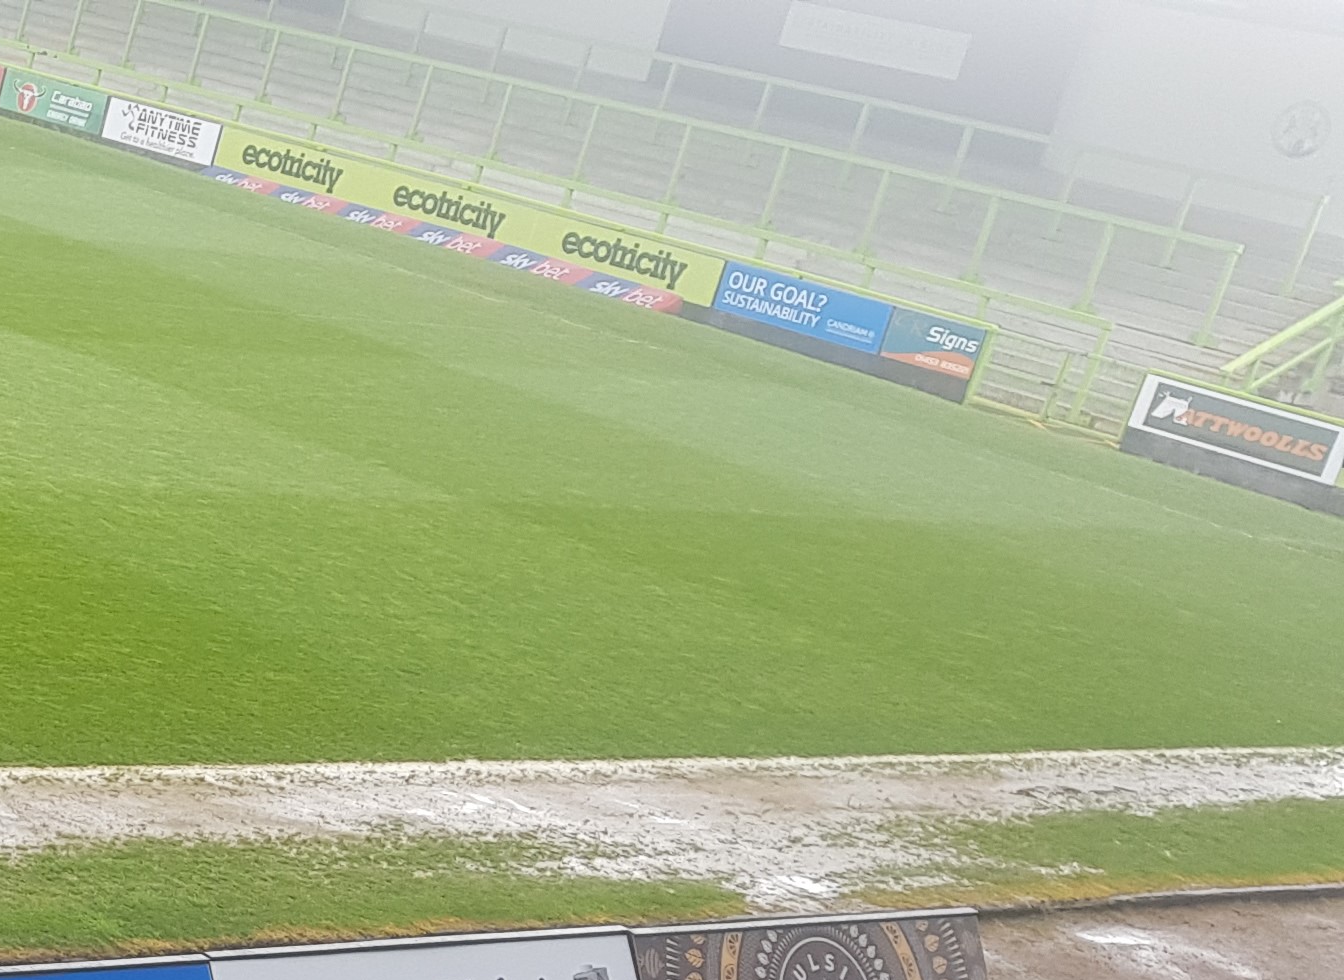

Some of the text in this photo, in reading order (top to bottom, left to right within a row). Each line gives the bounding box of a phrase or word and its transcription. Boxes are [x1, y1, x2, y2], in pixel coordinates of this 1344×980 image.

[135, 122, 197, 149] FITNESS
[137, 108, 202, 137] ANYTIME
[242, 142, 344, 194] ecotricity
[393, 185, 506, 239] ecotricity
[500, 252, 571, 281] sky bet
[562, 231, 688, 290] ecotricity
[589, 281, 664, 309] sky bet
[722, 291, 821, 328] SUSTAINABILITY
[728, 271, 828, 312] OUR GOAL?
[925, 326, 980, 353] Signs
[1176, 408, 1329, 462] ATTWOOLLS
